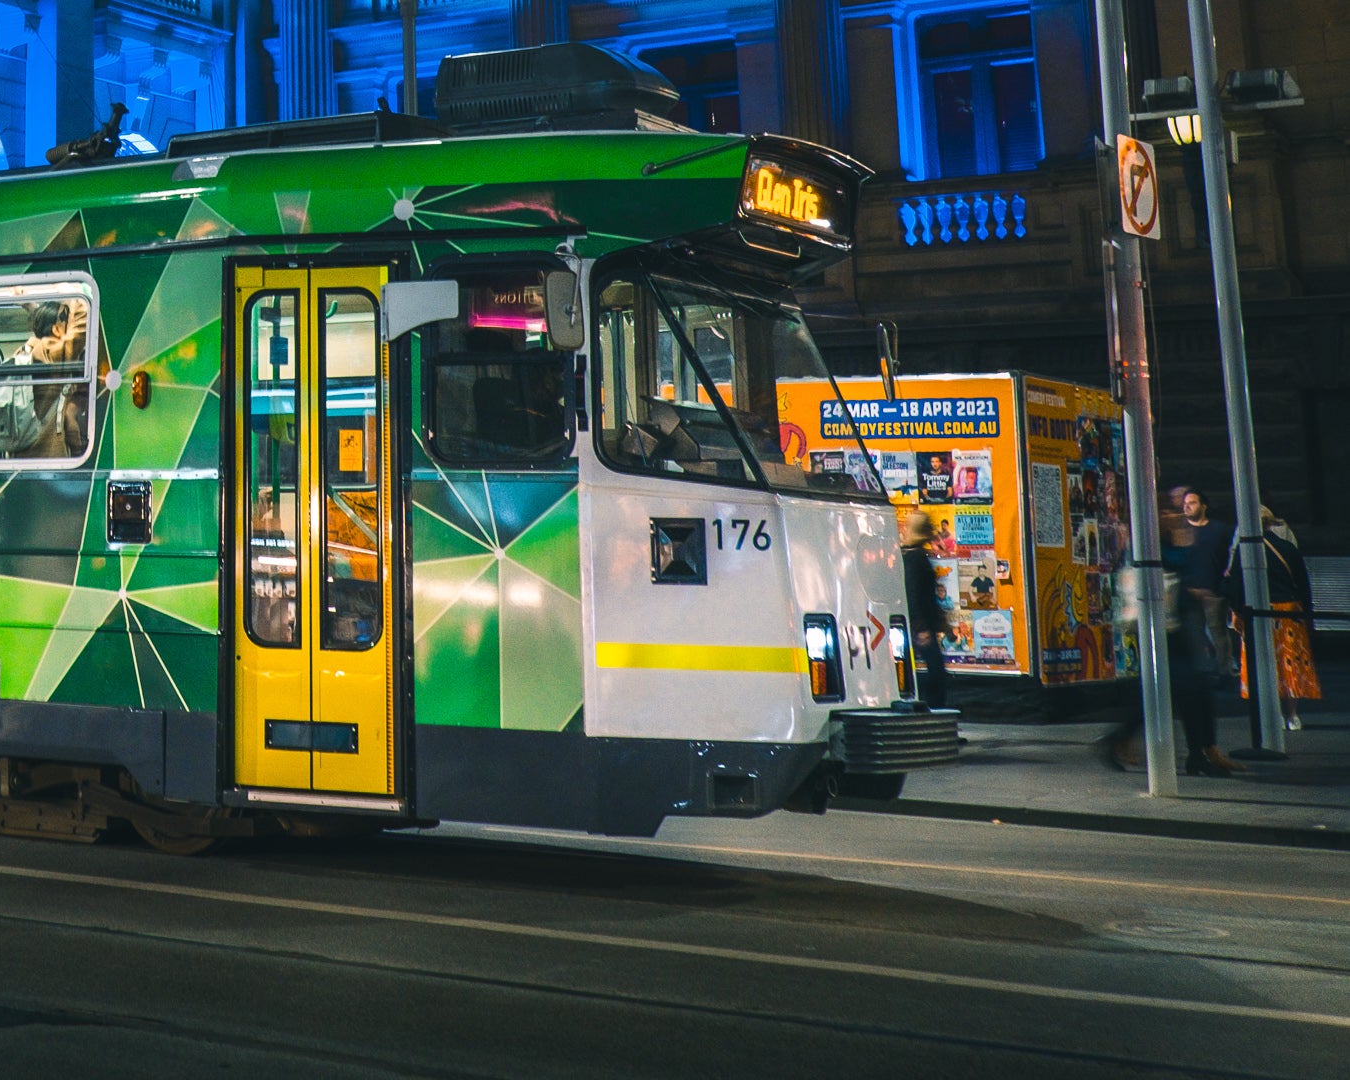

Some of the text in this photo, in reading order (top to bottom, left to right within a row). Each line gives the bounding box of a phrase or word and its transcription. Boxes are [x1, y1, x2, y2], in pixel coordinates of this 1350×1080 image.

[757, 168, 819, 222] Glen Iris
[823, 403, 843, 418] 24
[848, 402, 880, 418] MAR
[900, 401, 919, 417] 18
[922, 401, 952, 417] APR
[956, 400, 996, 417] 2021
[922, 473, 950, 482] Tommy
[927, 480, 947, 488] Little
[712, 518, 772, 552] 176
